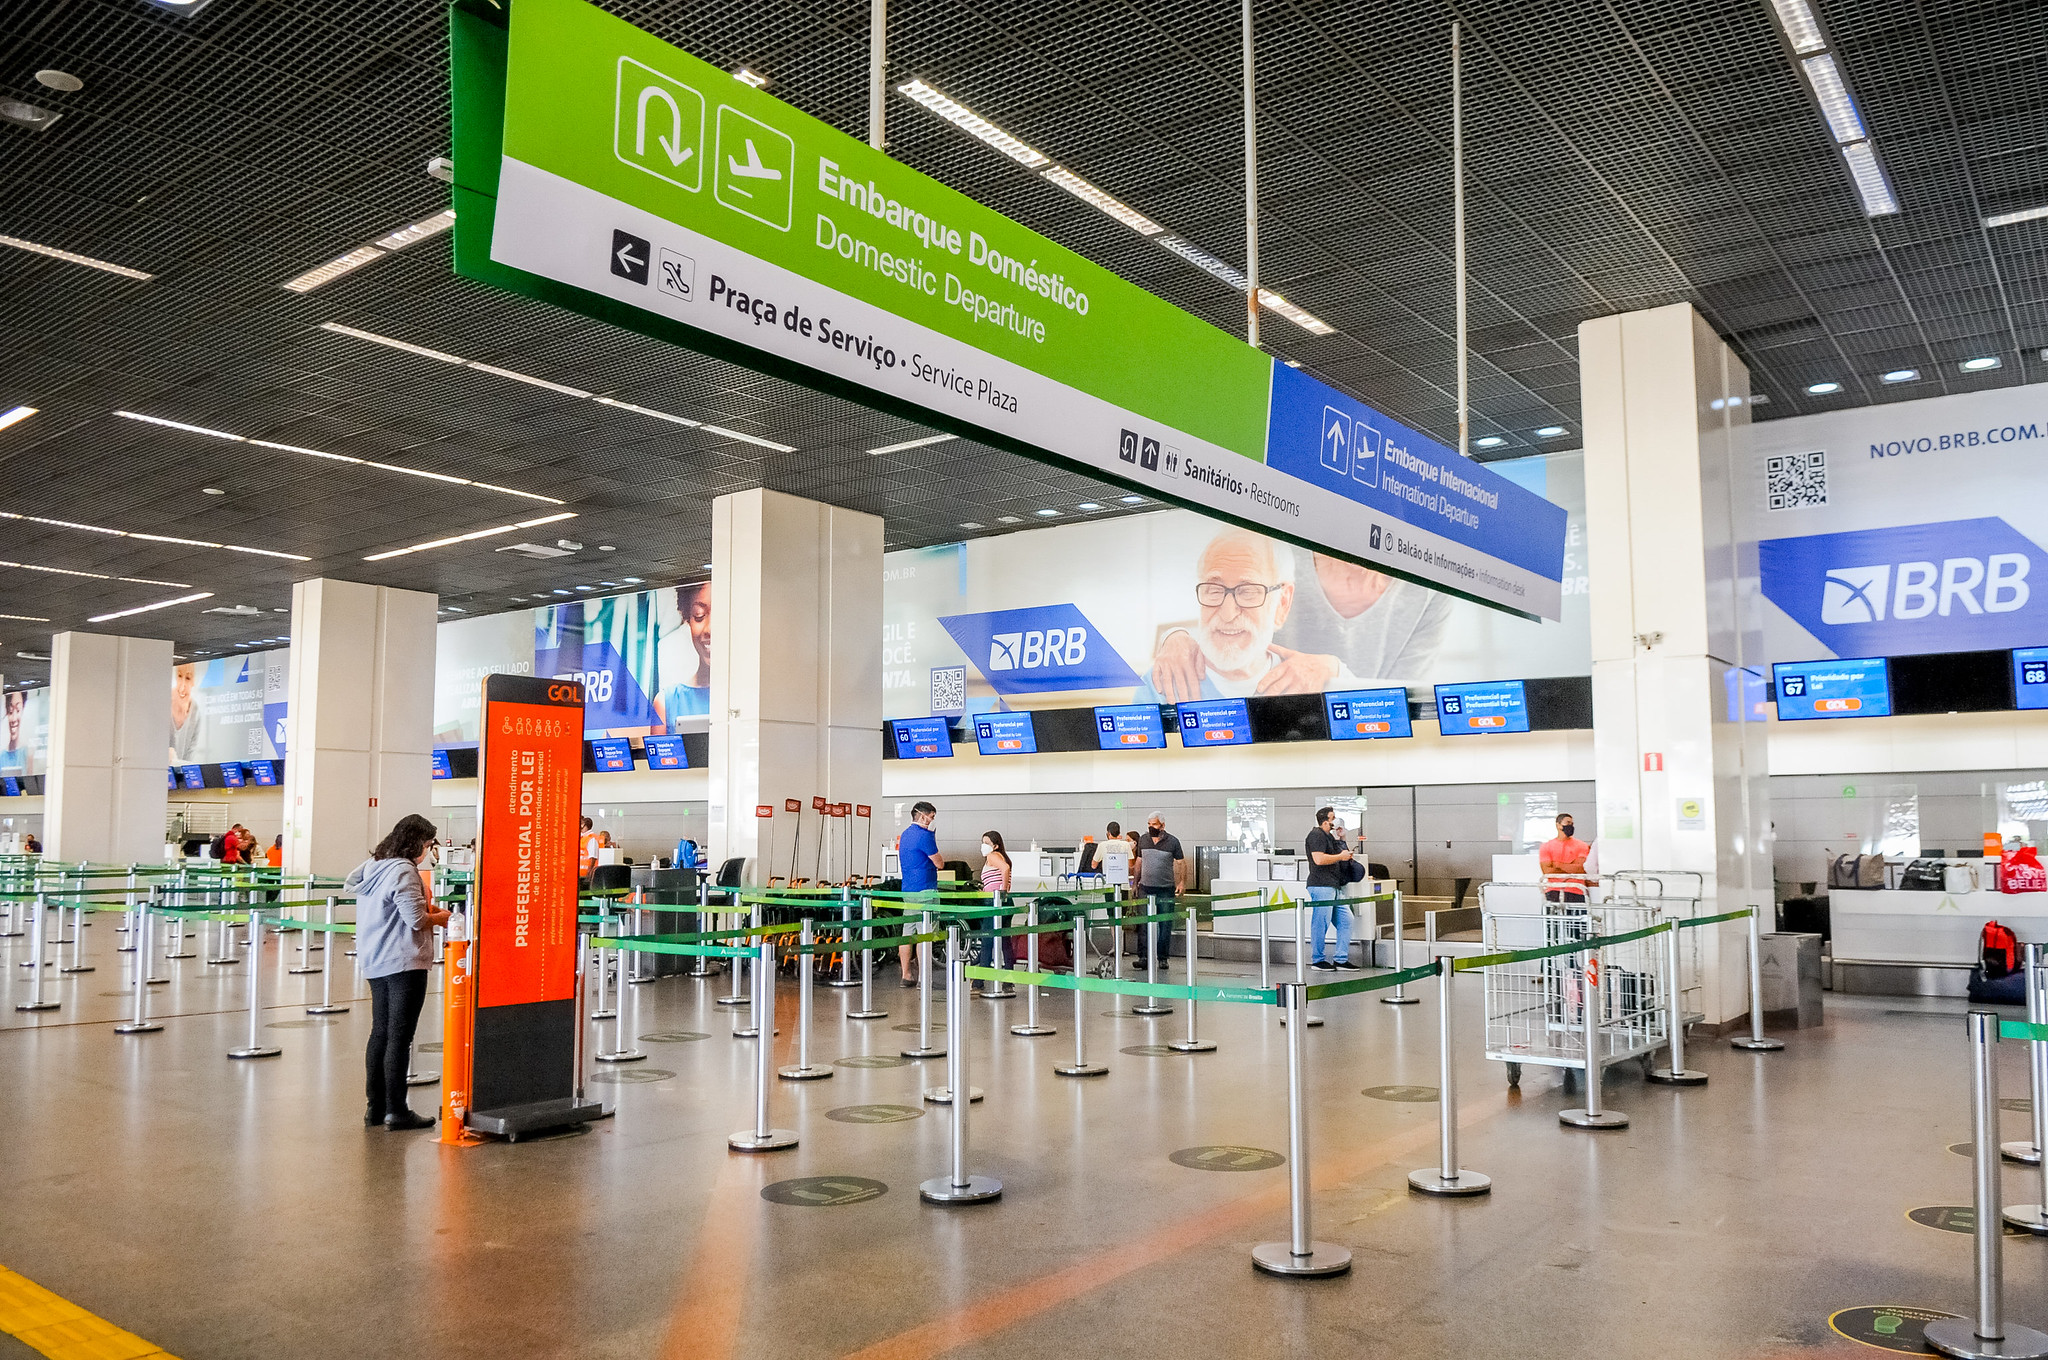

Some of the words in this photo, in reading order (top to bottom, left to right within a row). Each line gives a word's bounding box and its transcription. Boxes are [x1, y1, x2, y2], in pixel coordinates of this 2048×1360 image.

[818, 156, 962, 256] Embarque
[969, 229, 1090, 317] Doméstico
[816, 213, 937, 296] Domestic
[944, 274, 1047, 345] Departure
[710, 275, 777, 327] Praça
[783, 304, 812, 338] de
[818, 317, 896, 371] Serviço
[911, 353, 974, 398] Service
[978, 375, 1018, 414] Plaza
[1870, 422, 2048, 458] NOVO.BRB.COM.
[1384, 438, 1439, 482] Embarque
[1440, 465, 1499, 510] Internacional
[1184, 458, 1242, 495] Sanitários
[1250, 482, 1300, 517] Restrooms
[1382, 470, 1438, 512] International
[1439, 496, 1479, 529] Departure
[1397, 538, 1422, 560] Balcão
[1424, 548, 1433, 564] de
[1434, 552, 1475, 579] Informações
[883, 567, 916, 582] OM.BR
[1893, 553, 2031, 620] BRB
[883, 624, 903, 641] GIL
[907, 622, 916, 639] E
[883, 641, 916, 665] OCÊ.
[1023, 627, 1087, 669] BRB
[883, 669, 916, 688] NTA.
[2026, 670, 2046, 683] 68
[548, 684, 581, 702] GOL
[1786, 683, 1803, 695] 67
[1335, 709, 1348, 719] 64
[1445, 702, 1460, 713] 65
[1825, 700, 1848, 709] GOL
[1102, 722, 1113, 731] 62
[1185, 718, 1196, 727] 63
[1478, 718, 1496, 726] GOL
[900, 734, 909, 742] 60
[981, 729, 990, 737] 61
[521, 751, 535, 774] LEI
[536, 751, 544, 784] especial
[508, 750, 519, 814] atendimento
[520, 780, 534, 815] POR
[535, 786, 544, 829] prioridade
[534, 831, 542, 848] tem
[515, 821, 533, 947] PREFERENCIAL
[533, 872, 541, 884] 80
[533, 885, 540, 896] de
[452, 974, 466, 985] GO
